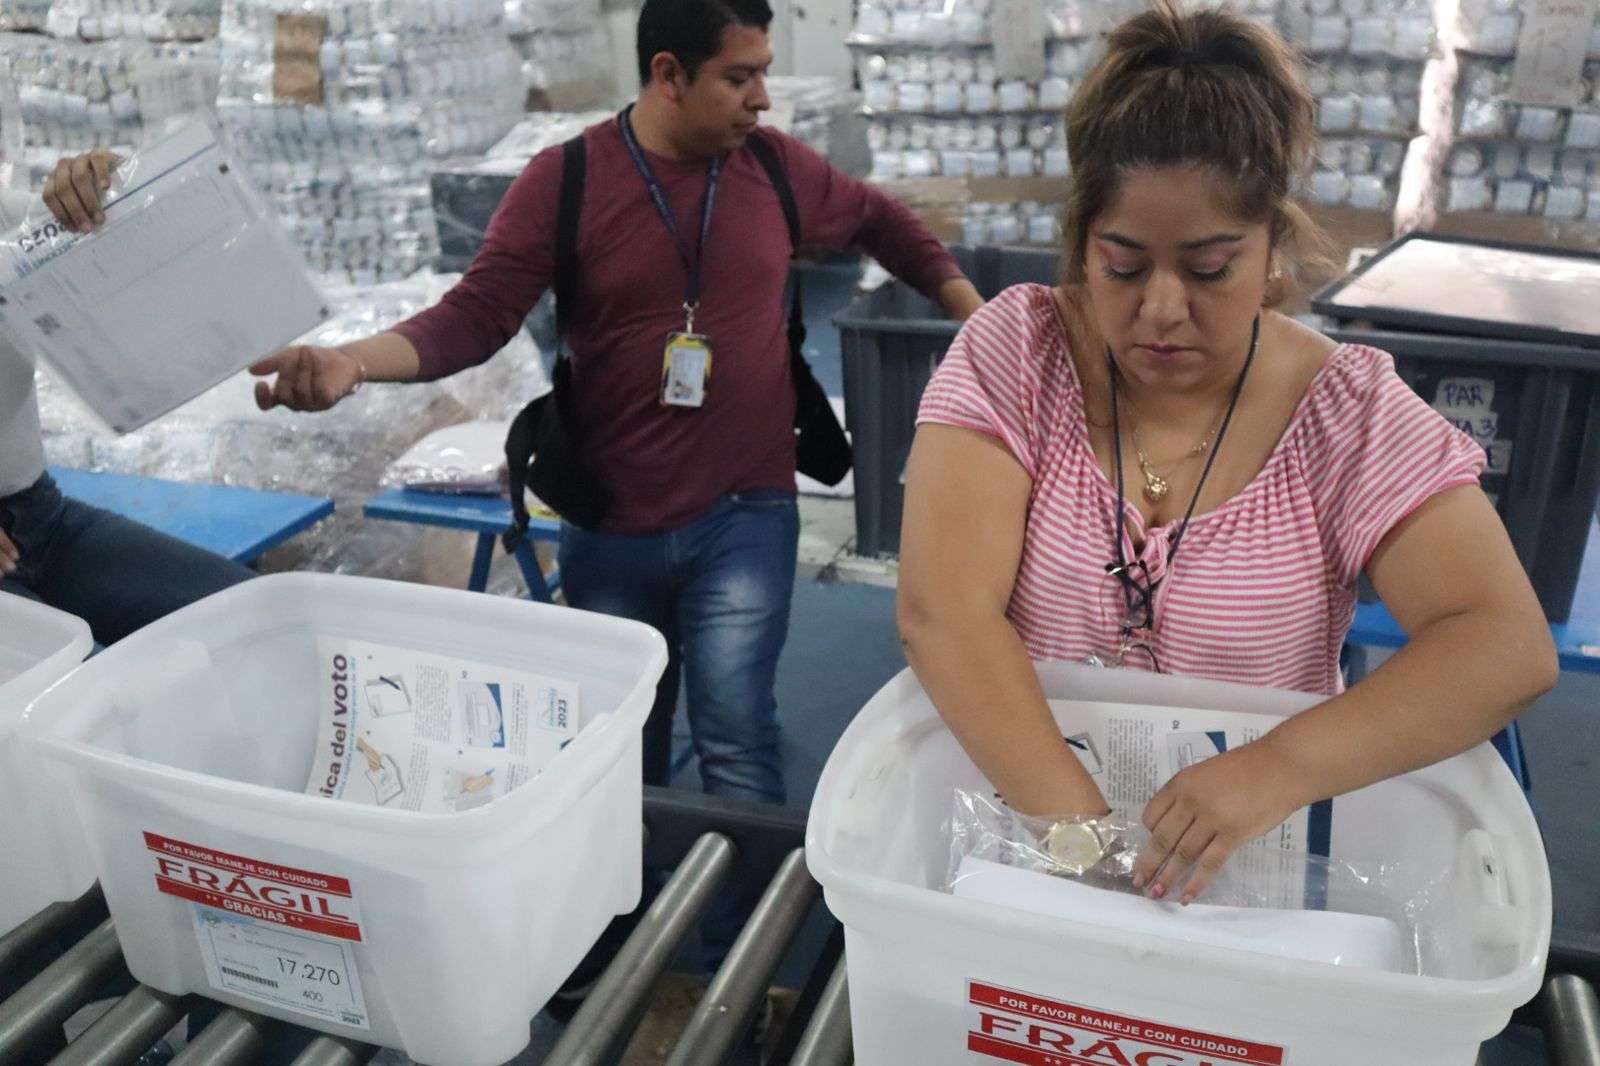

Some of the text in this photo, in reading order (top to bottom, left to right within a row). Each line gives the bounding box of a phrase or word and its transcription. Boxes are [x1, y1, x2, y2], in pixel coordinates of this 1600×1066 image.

[333, 653, 348, 718] voto
[558, 699, 567, 728] 2023
[332, 722, 347, 758] del
[156, 856, 350, 920] FRÁGIL
[163, 842, 328, 889] POR FAVOR MANEJE CON CUIDADO
[223, 899, 287, 923] GRACIAS
[1000, 995, 1249, 1057] POR FAVOR MANEJE CON CUIDADO
